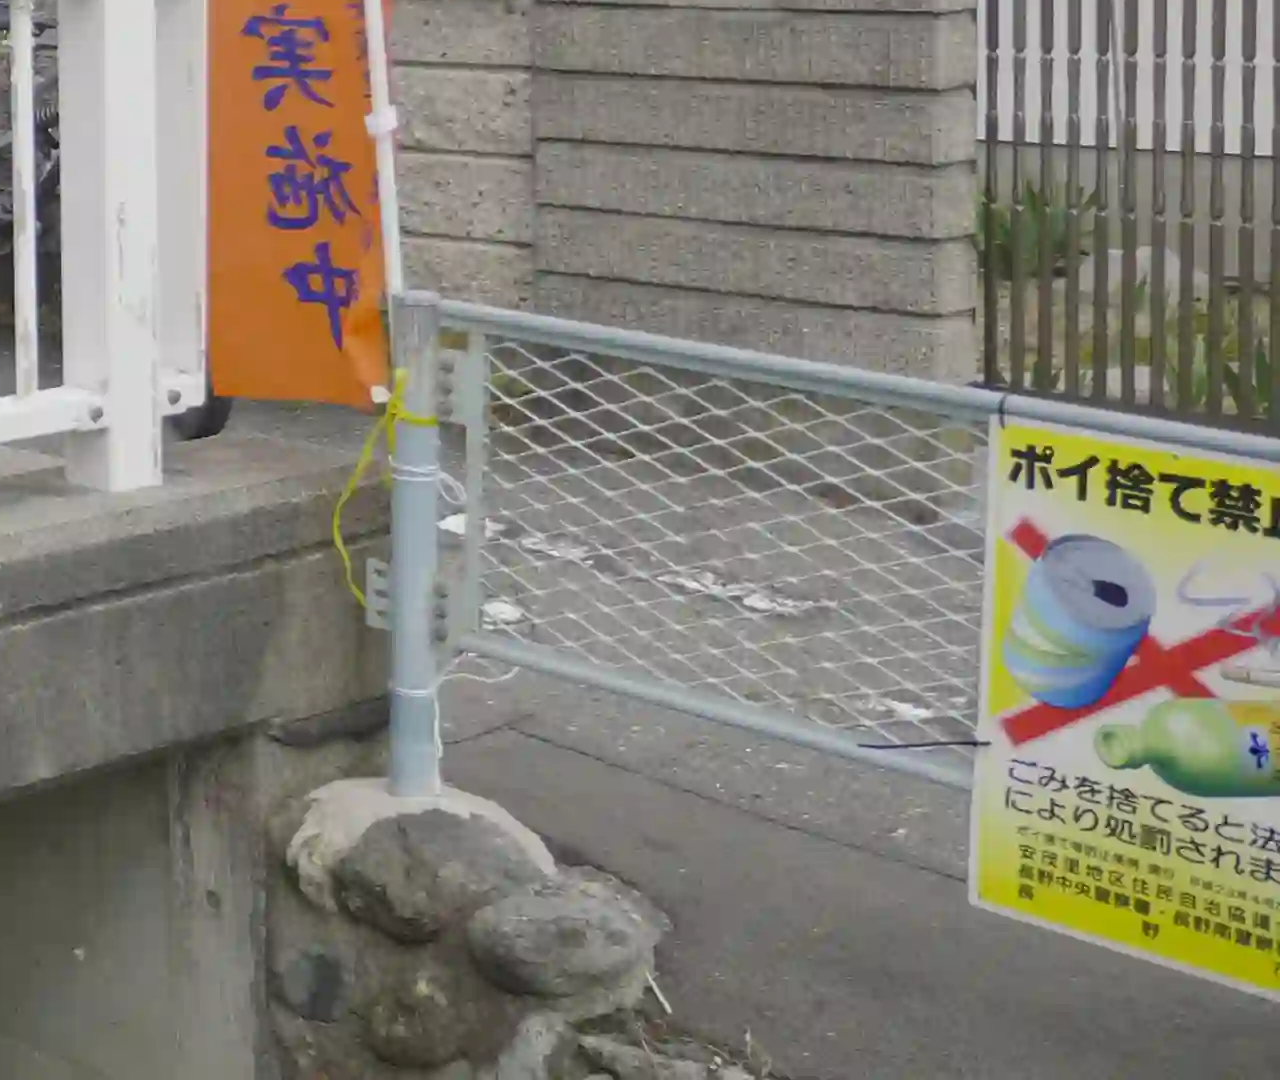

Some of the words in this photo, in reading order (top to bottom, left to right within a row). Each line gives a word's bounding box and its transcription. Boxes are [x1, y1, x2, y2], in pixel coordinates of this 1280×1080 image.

[1017, 843, 1280, 934] 安茂里地区住民自治協議
